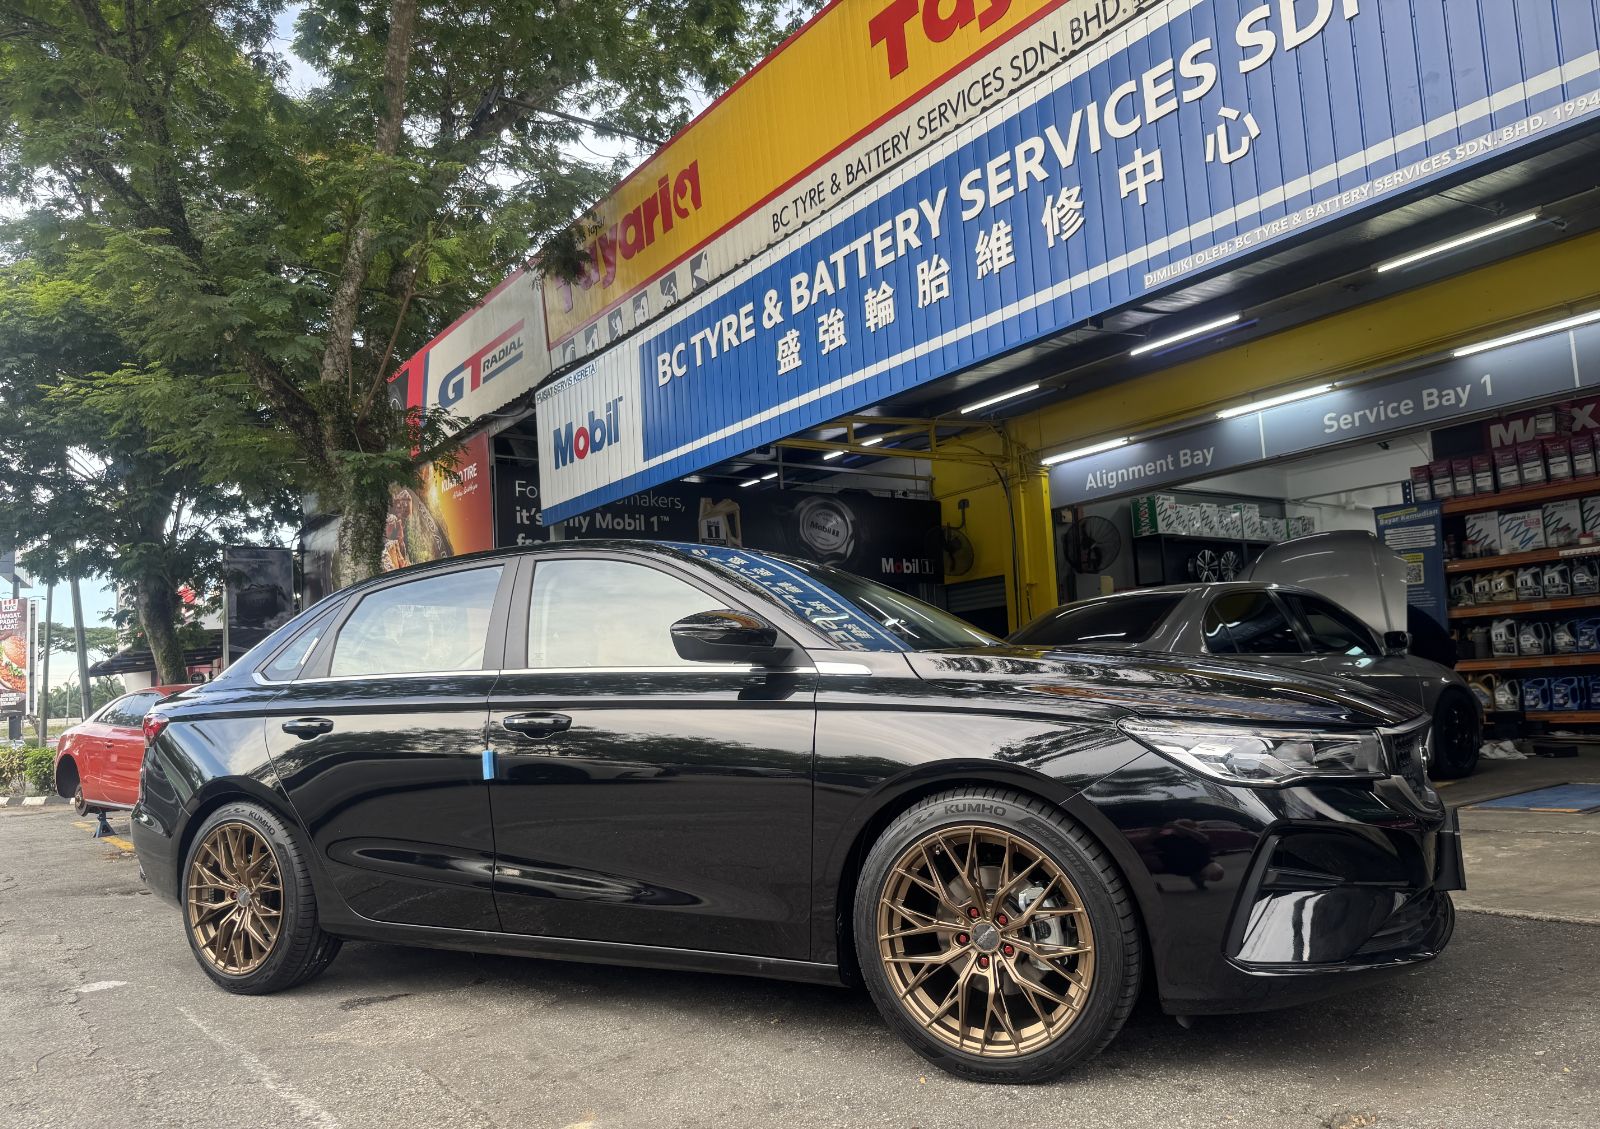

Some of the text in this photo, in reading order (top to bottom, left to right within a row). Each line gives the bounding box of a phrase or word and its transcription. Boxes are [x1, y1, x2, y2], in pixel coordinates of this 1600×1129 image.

[772, 0, 1127, 233] BC TYRE & BATTERY SERVICES SDN. BHD.
[657, 341, 688, 388] BC
[690, 302, 757, 368] TYRE
[762, 288, 785, 330] &
[790, 186, 948, 316] BATTERY
[959, 37, 1218, 222] SERVICES
[1145, 257, 1193, 286] DIMILIKI
[1196, 242, 1233, 265] OLEH:
[1235, 235, 1252, 251] BC
[1254, 217, 1289, 241] TYRE
[1292, 211, 1302, 225] &
[1305, 184, 1371, 221] BATTERY
[1374, 153, 1452, 193] SERVICES
[1456, 132, 1498, 160] SDN.
[1502, 115, 1547, 141] BHD.
[777, 106, 1261, 376] 盛強輪胎維修中心
[438, 318, 525, 409] GT
[482, 337, 524, 373] RADIAL
[537, 387, 553, 404] PUSAT
[553, 375, 573, 394] SERVIS
[1323, 374, 1493, 434] Service Bay 1
[553, 397, 621, 471] Mobil
[463, 462, 478, 483] TIRE
[1085, 447, 1215, 491] Alignment Bay
[515, 480, 538, 498] Fo
[595, 513, 645, 531] Mobil
[1400, 509, 1439, 521] Kemudian
[881, 557, 920, 575] Mobil
[248, 810, 276, 837] KUMHO
[944, 803, 1007, 817] KUMHO
